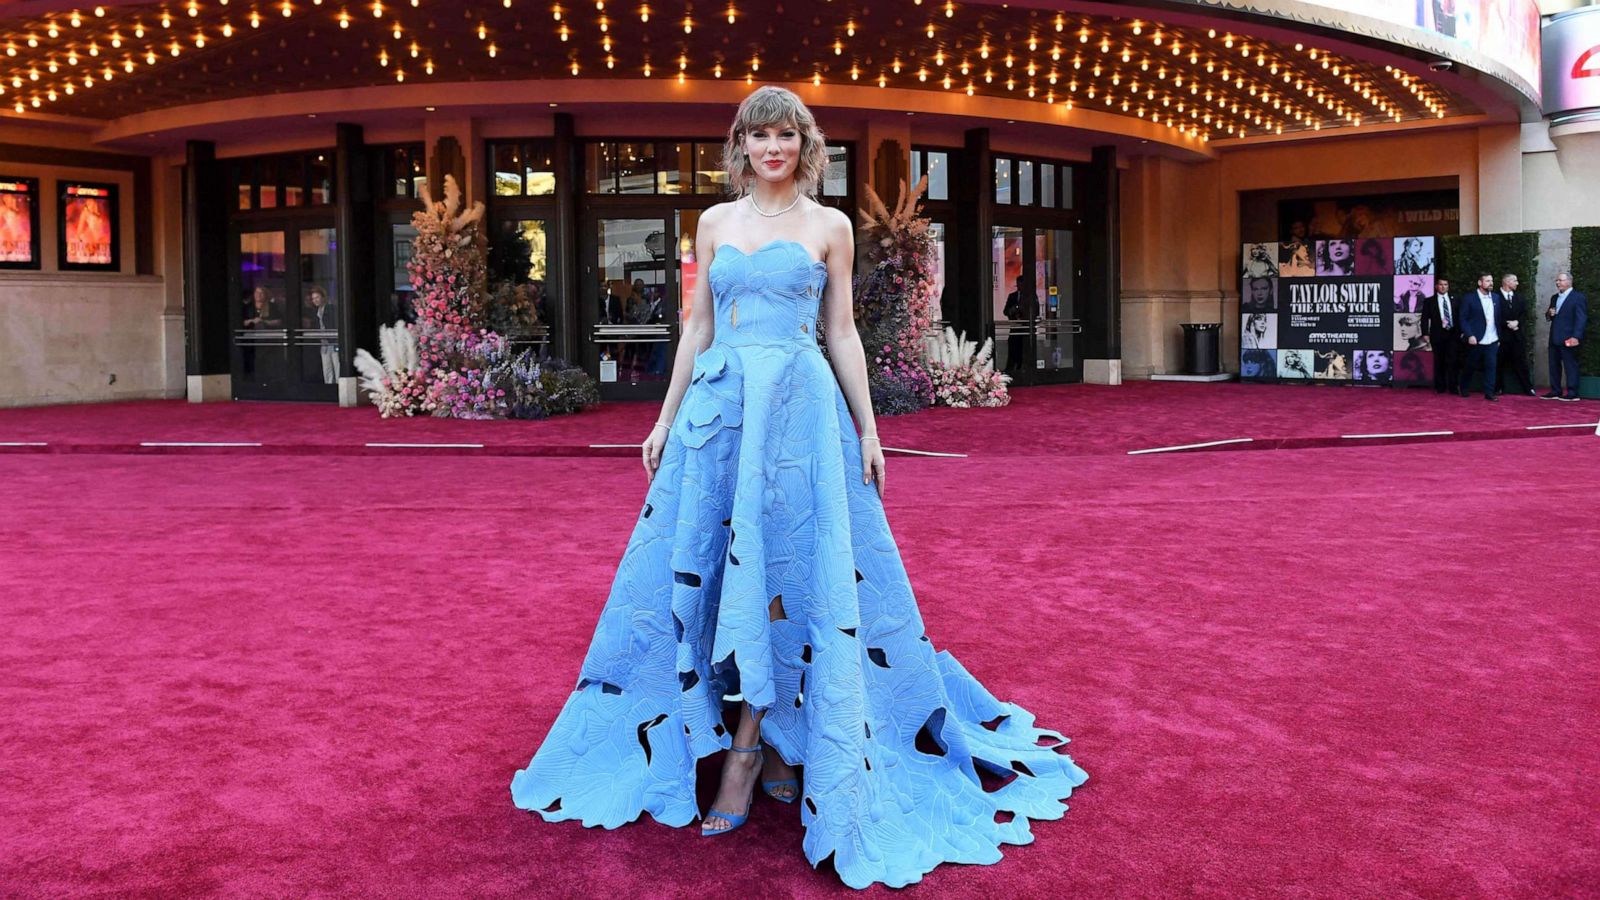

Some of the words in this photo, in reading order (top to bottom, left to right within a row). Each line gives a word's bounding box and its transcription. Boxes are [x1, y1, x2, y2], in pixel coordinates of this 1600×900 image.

[1405, 210, 1442, 222] WILD
[1290, 284, 1338, 303] TAYLOR
[1340, 283, 1380, 303] SWIFT
[1290, 303, 1314, 313] THE
[1315, 303, 1346, 313] ERAS
[1347, 303, 1380, 313] TOUR
